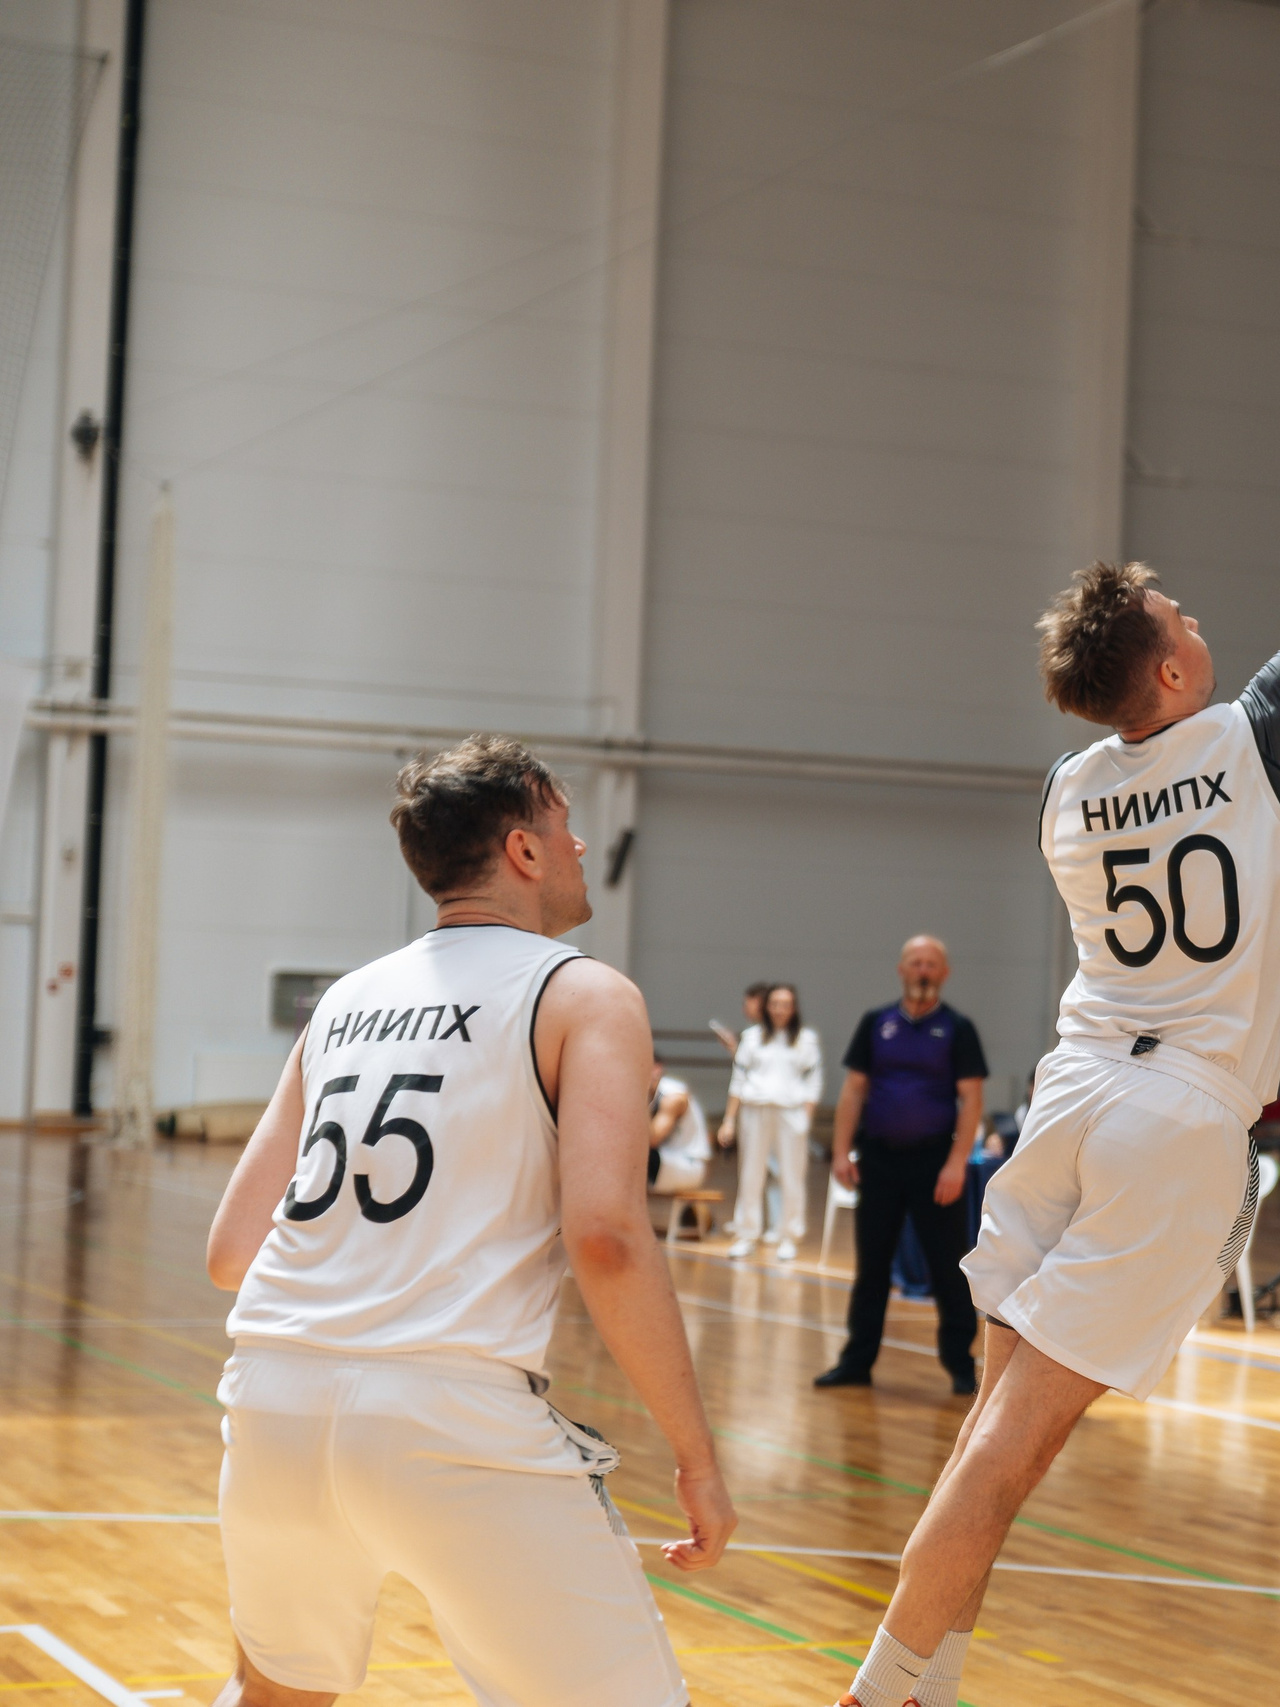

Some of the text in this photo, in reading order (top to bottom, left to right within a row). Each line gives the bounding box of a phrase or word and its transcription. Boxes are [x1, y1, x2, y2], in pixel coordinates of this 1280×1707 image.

[1081, 770, 1232, 832] НИИПХ
[1102, 833, 1240, 968] 50
[323, 1004, 481, 1054] НИИПХ
[283, 1073, 445, 1224] 55
